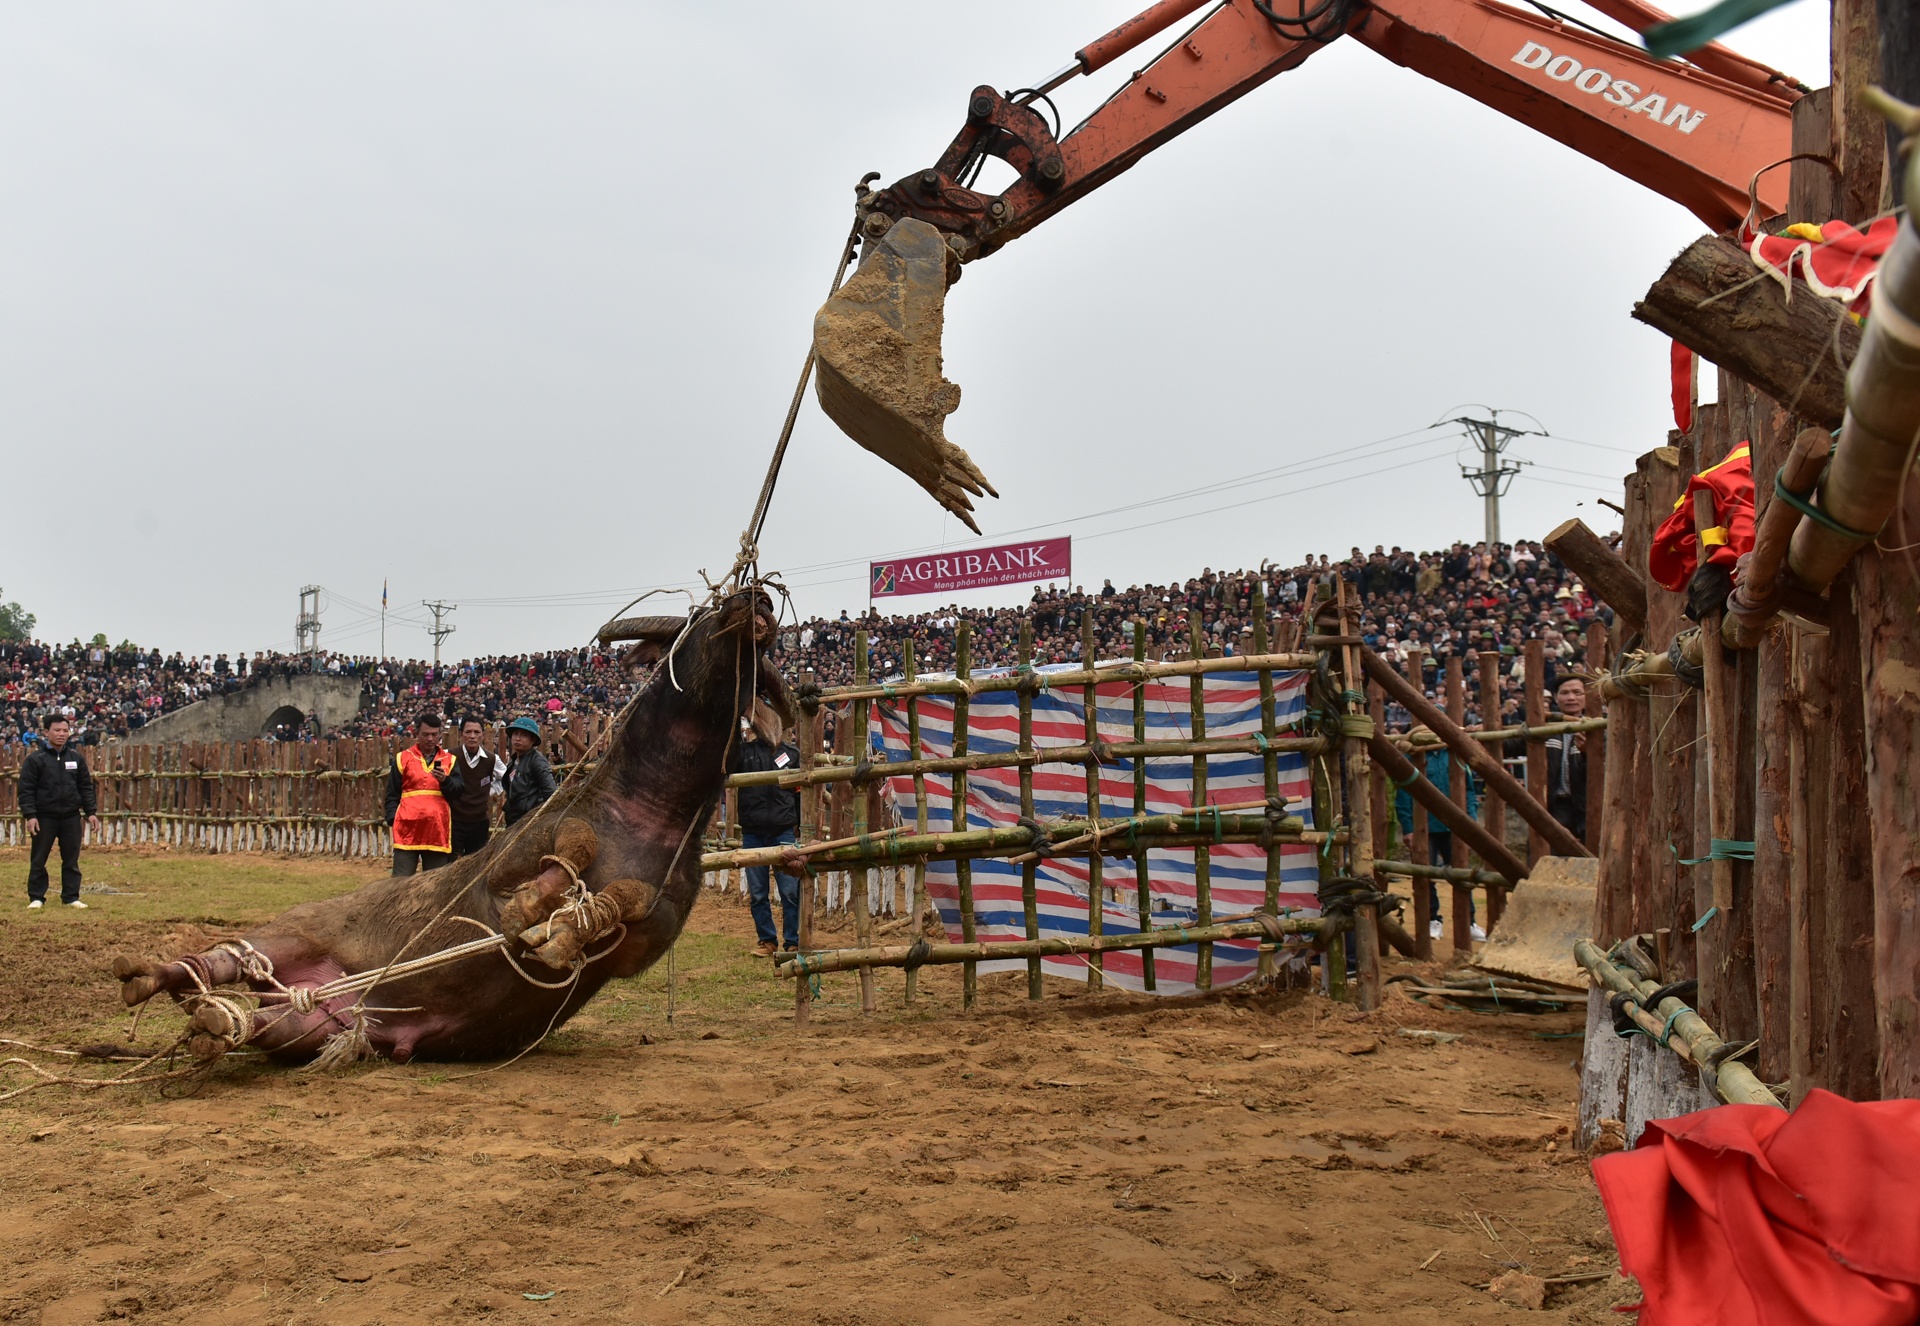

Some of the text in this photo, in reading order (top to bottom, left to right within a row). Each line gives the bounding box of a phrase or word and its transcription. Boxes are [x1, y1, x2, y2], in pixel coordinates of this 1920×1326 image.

[1510, 39, 1708, 135] DOOSAN
[898, 545, 1050, 582] AGRIBANK
[934, 581, 954, 590] Mang
[1018, 569, 1042, 580] khách
